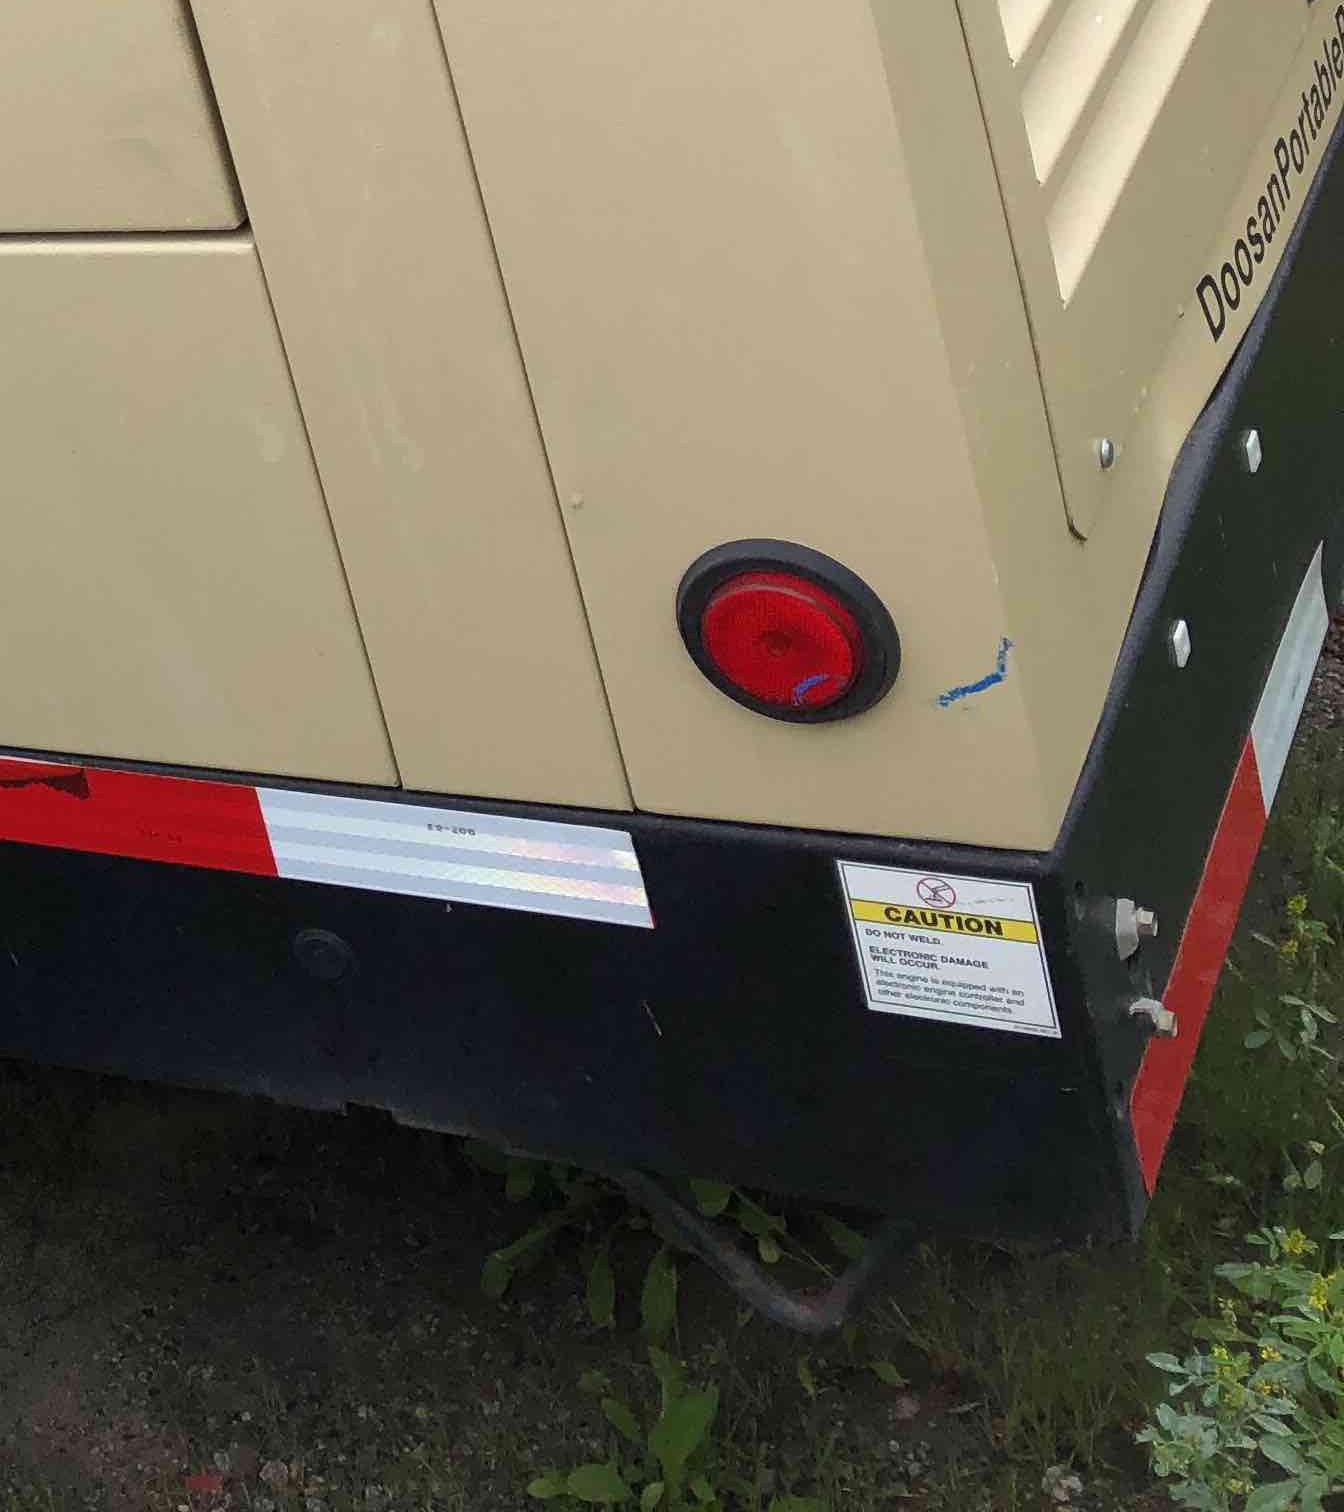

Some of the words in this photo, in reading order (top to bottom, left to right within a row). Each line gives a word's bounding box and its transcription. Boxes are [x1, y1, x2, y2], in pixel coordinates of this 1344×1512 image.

[884, 905, 1004, 937] CAUTION
[865, 927, 882, 938] DO
[883, 930, 906, 941] NOT
[868, 945, 938, 963] ELECTRONIC
[940, 954, 990, 970] DAMAGE
[869, 953, 897, 965] WILL
